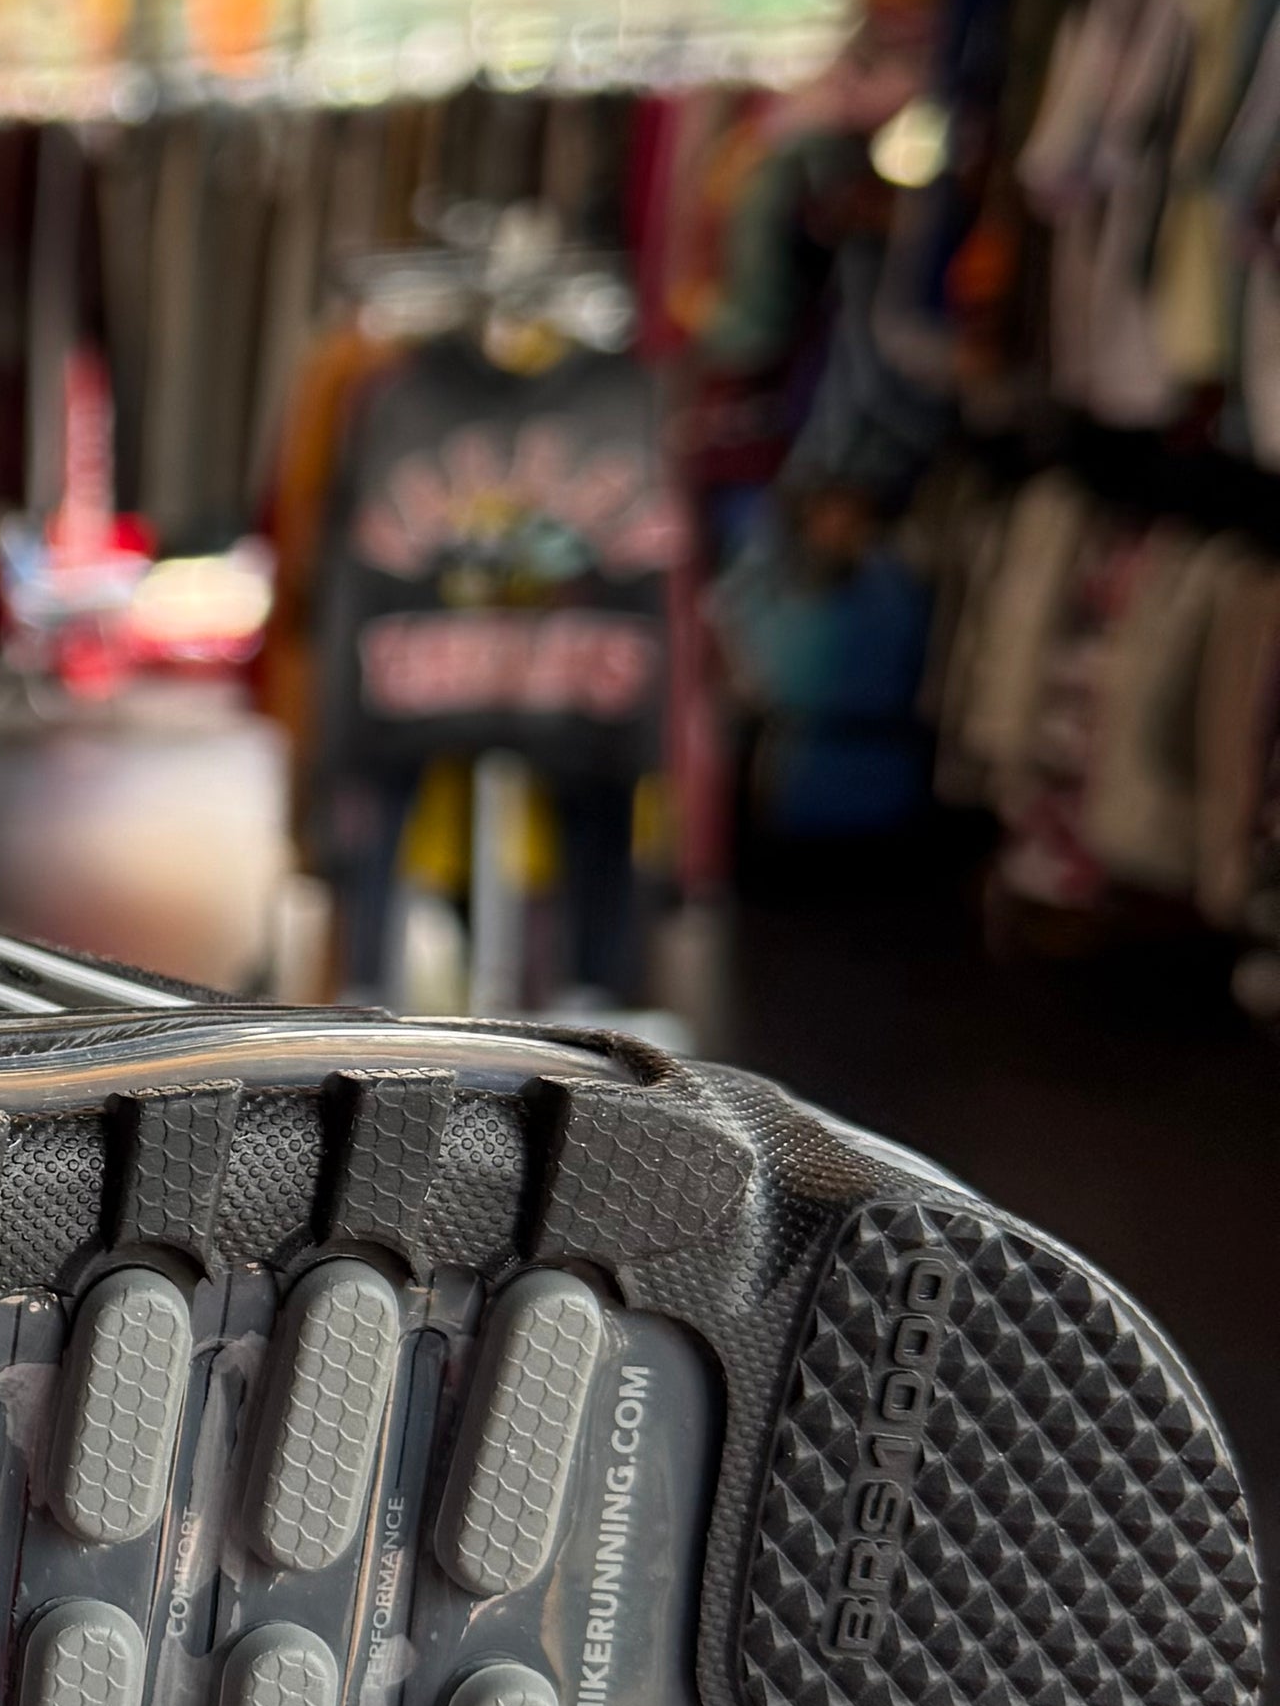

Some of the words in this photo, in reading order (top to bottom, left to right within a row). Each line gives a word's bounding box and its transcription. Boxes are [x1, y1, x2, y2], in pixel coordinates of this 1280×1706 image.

[838, 1257, 945, 1651] BRS1000
[168, 1506, 202, 1637] COMFORT
[364, 1495, 405, 1690] PERFORMANCE
